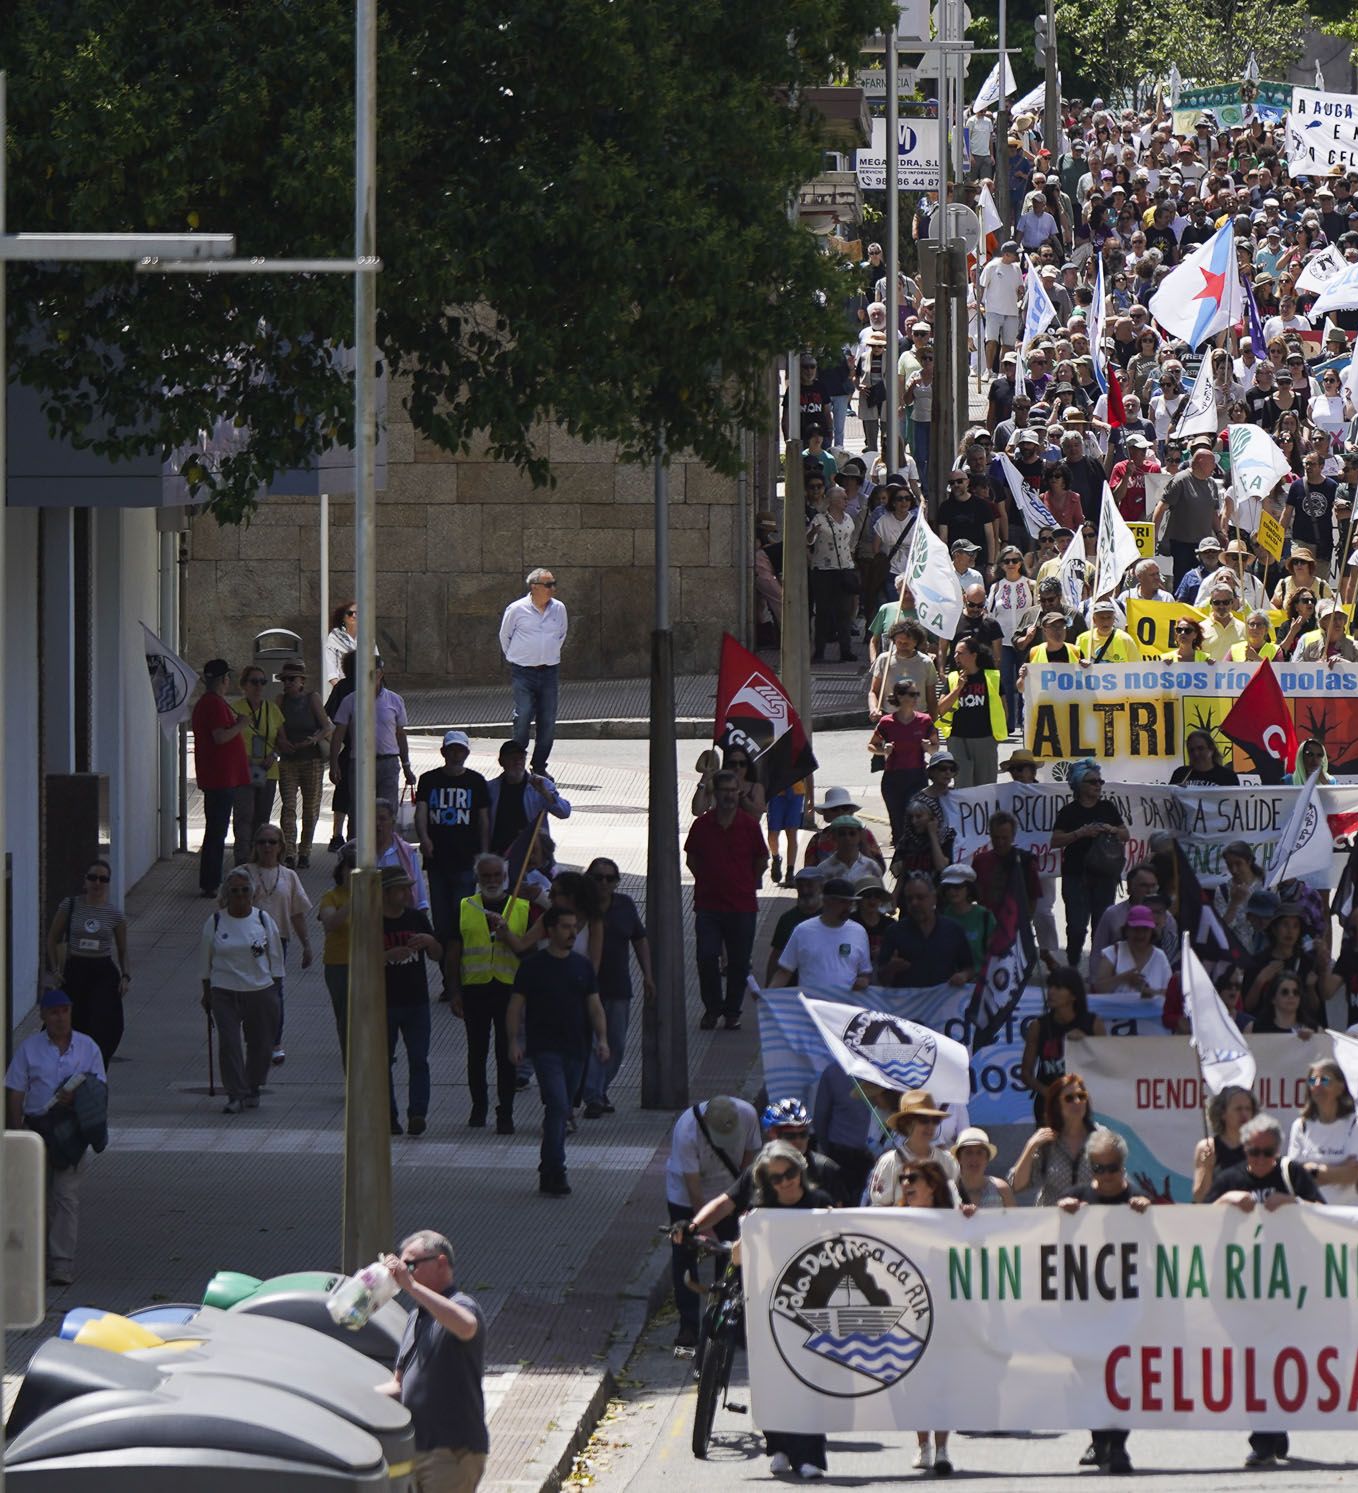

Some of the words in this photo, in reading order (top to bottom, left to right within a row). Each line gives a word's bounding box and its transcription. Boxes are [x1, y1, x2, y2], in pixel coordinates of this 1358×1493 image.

[1298, 99, 1306, 114] A
[1313, 101, 1353, 119] AUGA
[1333, 124, 1341, 140] E
[875, 178, 887, 186] 98
[912, 178, 926, 186] 44
[1130, 526, 1150, 538] TRI
[1040, 669, 1117, 691] Polos
[1124, 671, 1208, 691] nosos
[1214, 668, 1252, 691] río
[1280, 669, 1357, 693] polas
[1032, 701, 1176, 758] ALTRI
[429, 787, 473, 809] ALTRI
[1193, 797, 1208, 834] A
[1217, 793, 1283, 833] SAÚDE
[1260, 1078, 1308, 1109] LLO
[948, 1245, 1022, 1301] NIN
[1040, 1243, 1139, 1302] ENCE
[1155, 1244, 1210, 1299] NA
[1225, 1224, 1308, 1310] RÍA,
[773, 1274, 812, 1318] Pola
[798, 1241, 885, 1276] Defensa
[886, 1258, 908, 1286] da
[904, 1284, 931, 1321] RIA
